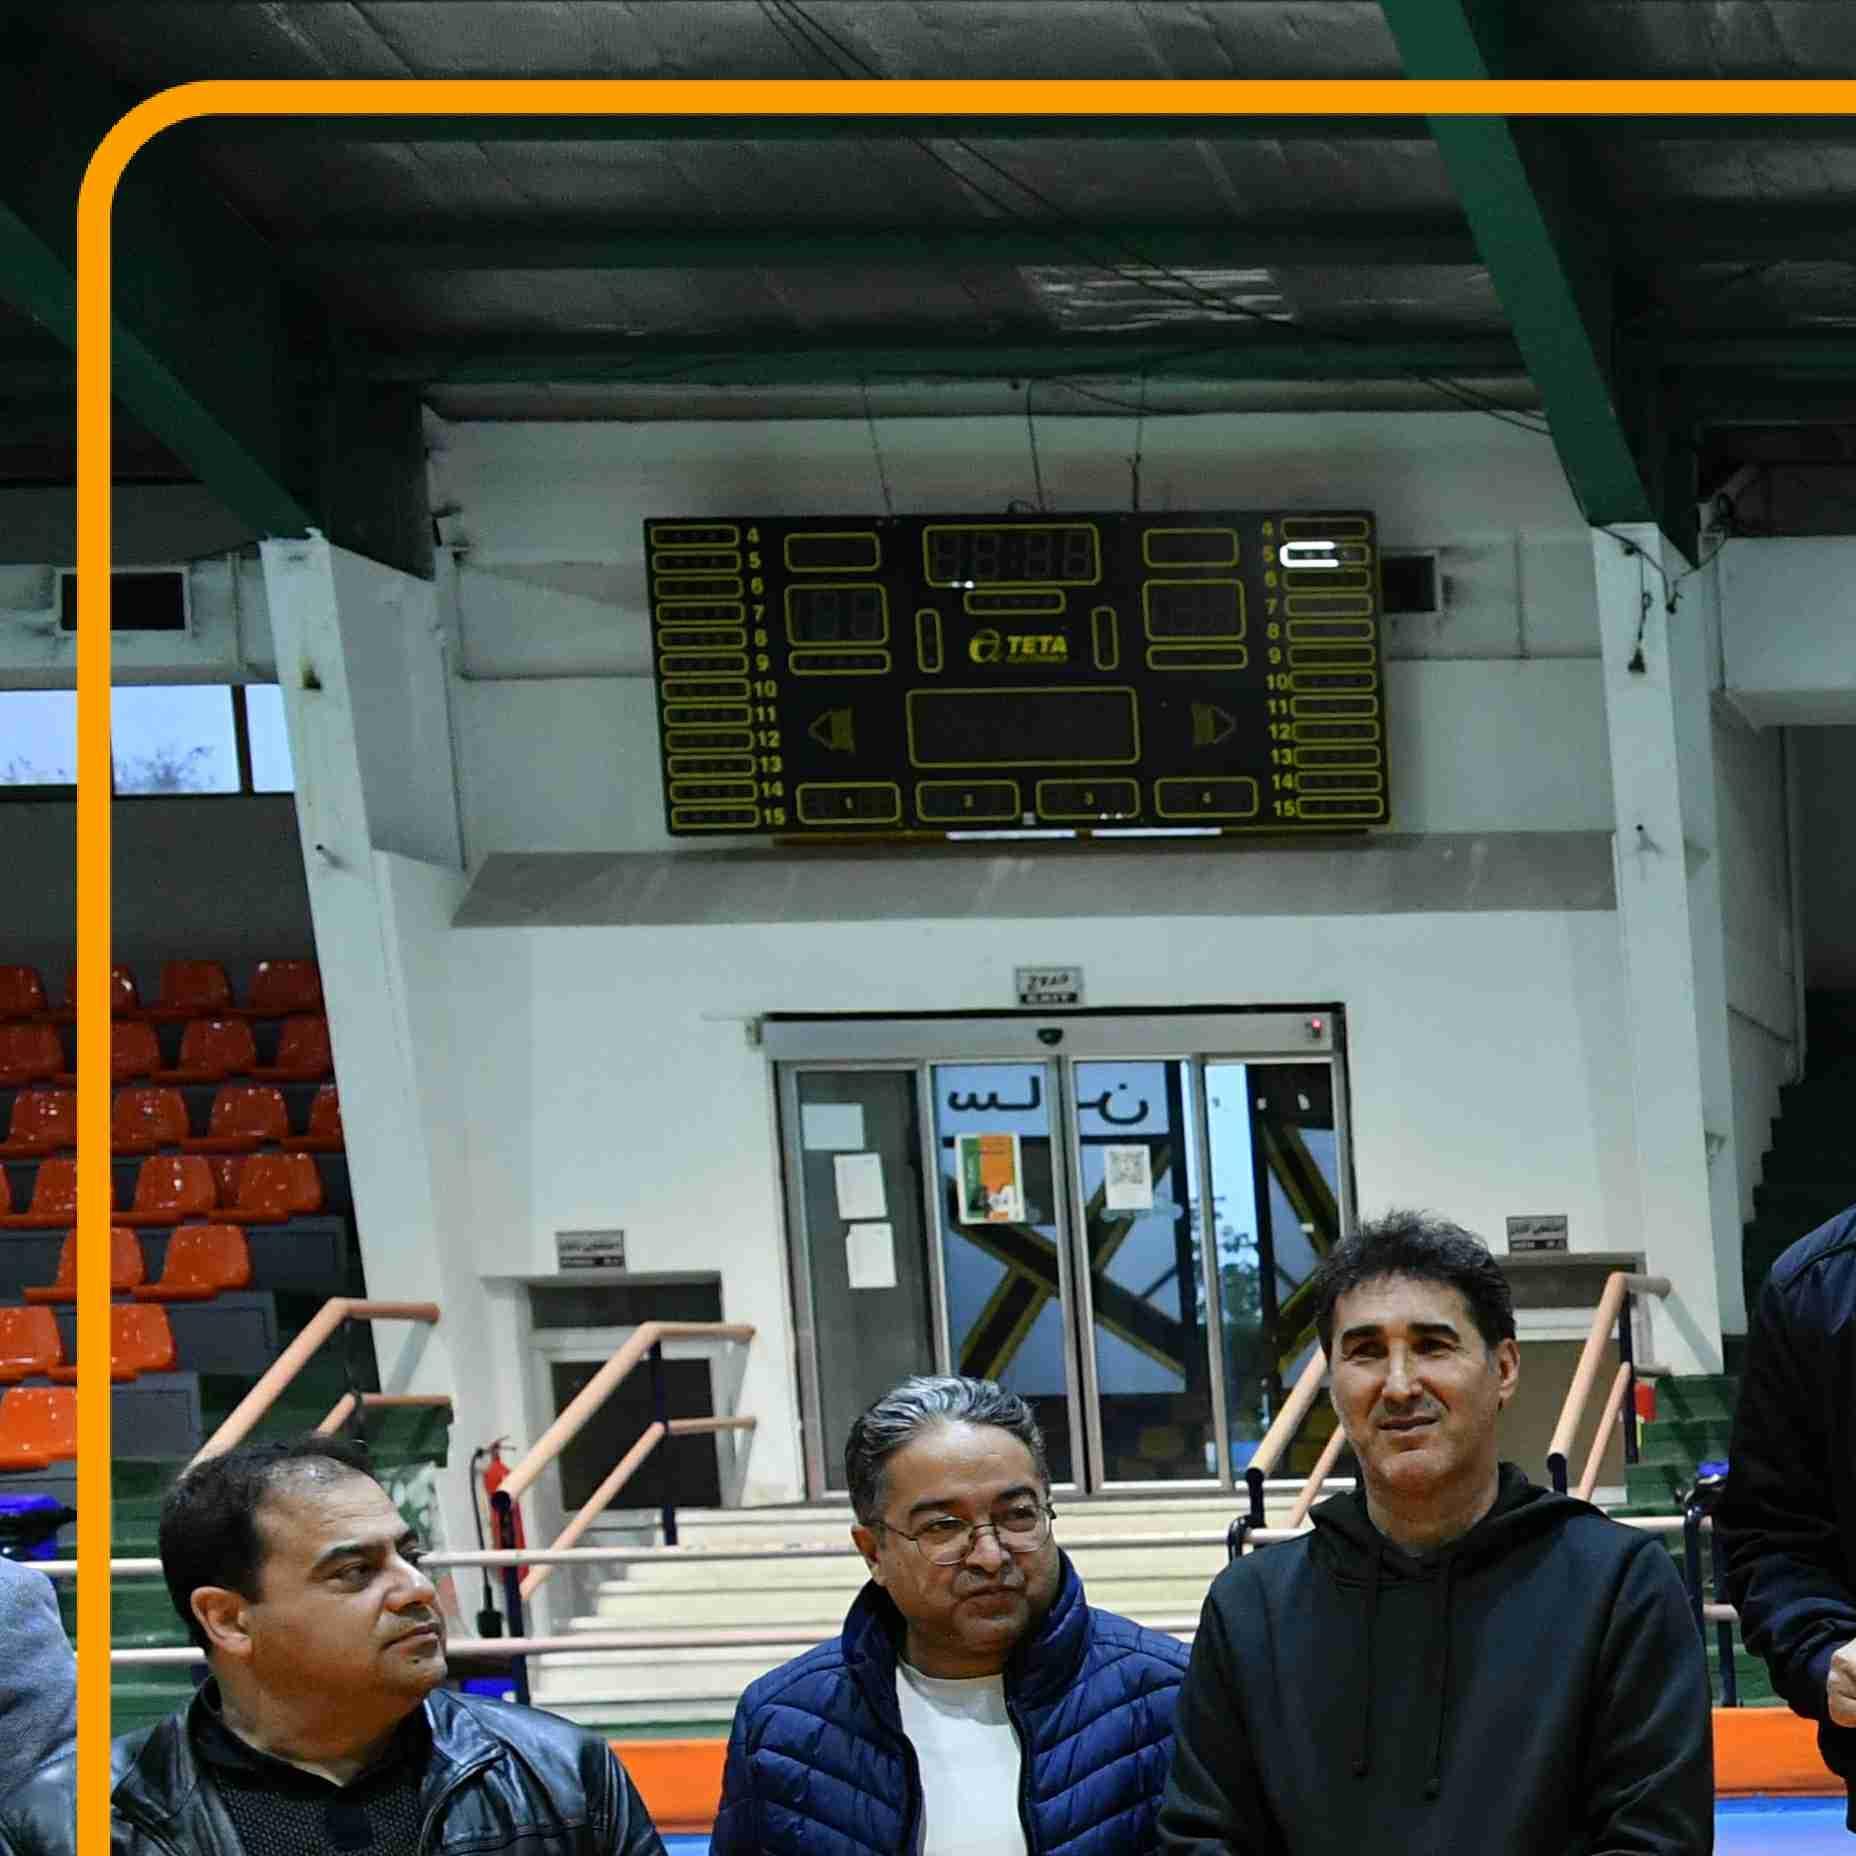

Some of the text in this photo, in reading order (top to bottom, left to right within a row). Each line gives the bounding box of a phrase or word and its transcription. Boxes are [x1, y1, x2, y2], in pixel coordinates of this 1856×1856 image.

[746, 528, 761, 544] 4
[748, 552, 762, 569] 5
[752, 604, 766, 621] 7
[1006, 634, 1069, 655] TETA
[755, 653, 769, 671] 9
[753, 680, 778, 697] 10
[755, 705, 777, 722] 11
[758, 730, 781, 748] 12
[761, 780, 784, 798] 14
[764, 807, 786, 825] 15
